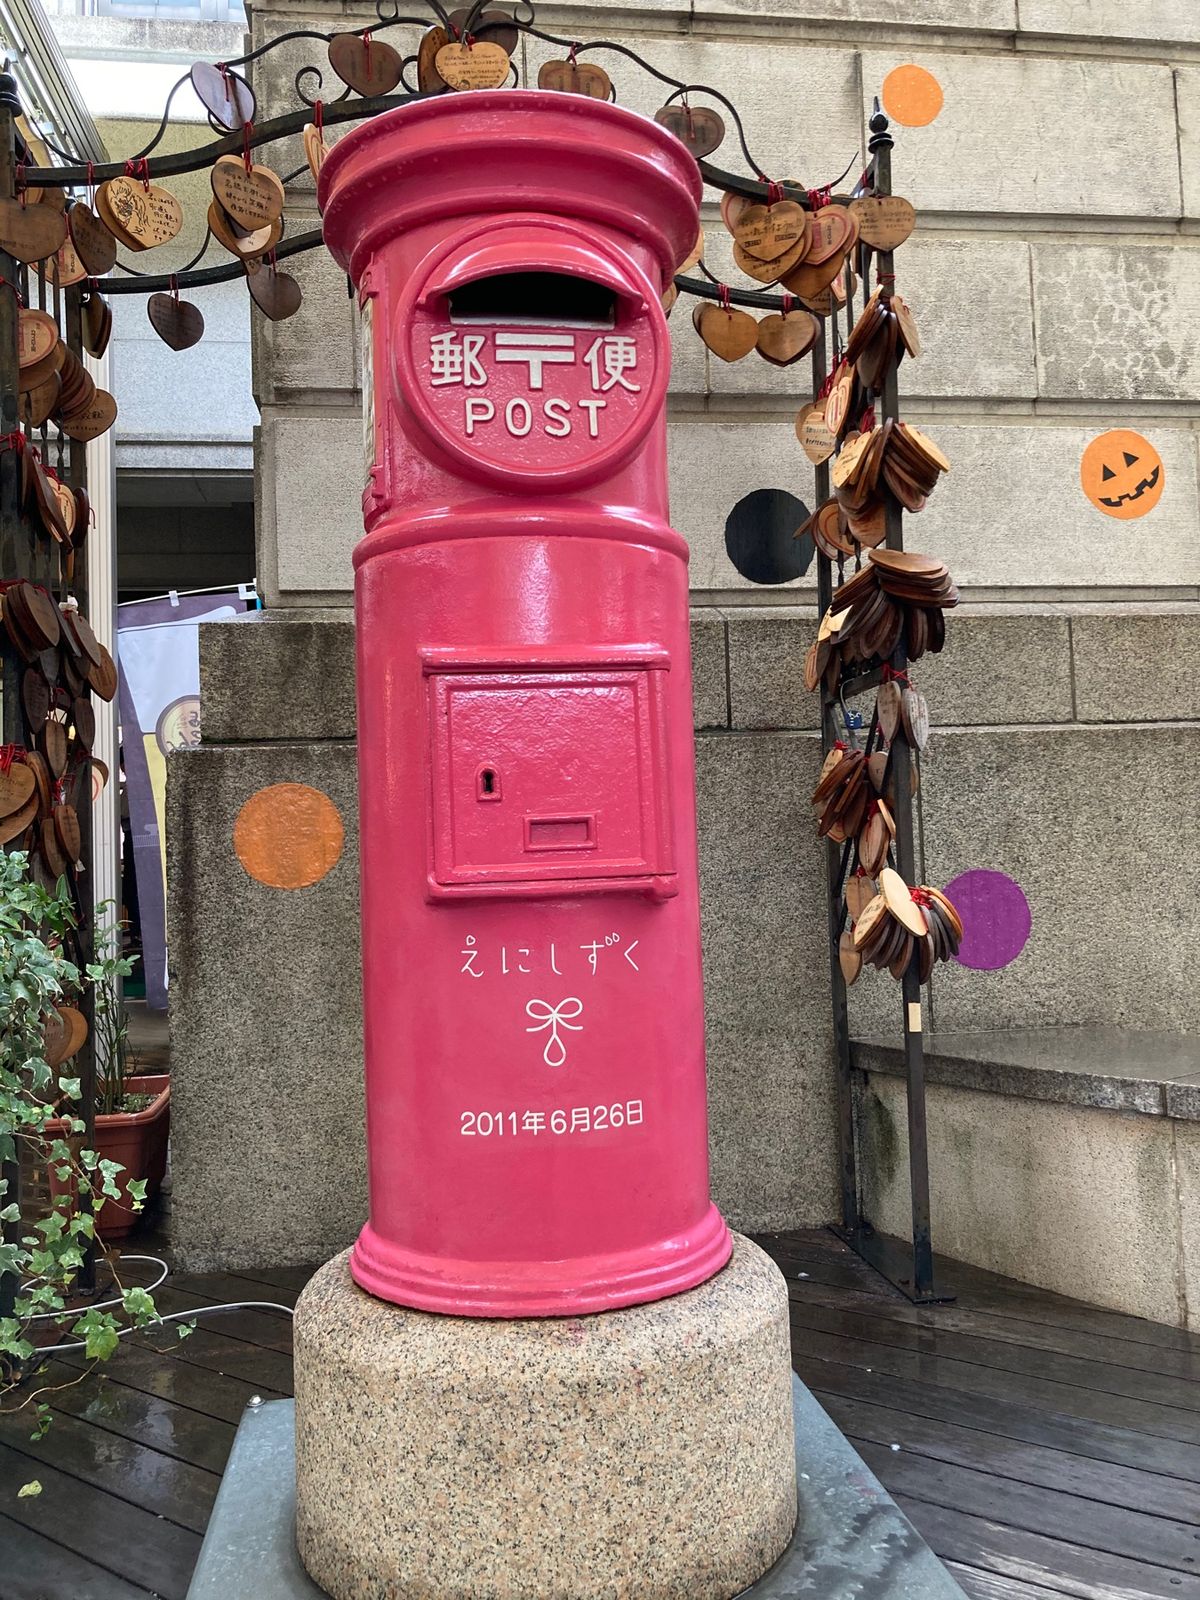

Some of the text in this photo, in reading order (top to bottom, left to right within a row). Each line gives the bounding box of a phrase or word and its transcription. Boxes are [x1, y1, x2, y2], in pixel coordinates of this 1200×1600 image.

[464, 398, 607, 437] POST
[460, 932, 640, 978] えにしずく
[460, 1099, 644, 1136] 2011年6月26日
